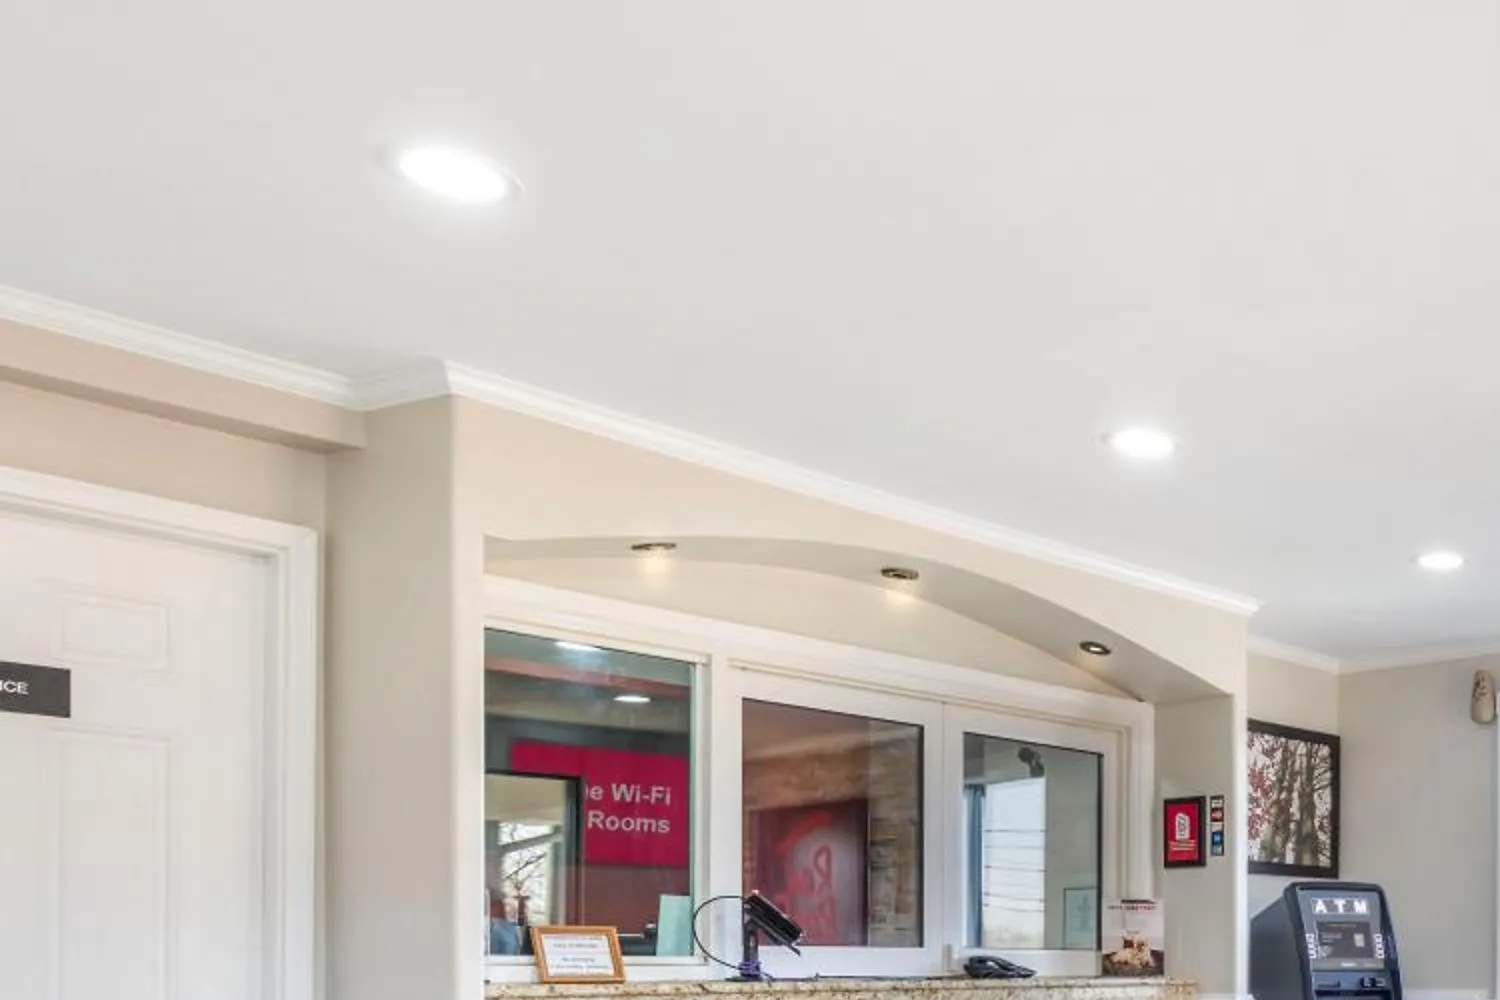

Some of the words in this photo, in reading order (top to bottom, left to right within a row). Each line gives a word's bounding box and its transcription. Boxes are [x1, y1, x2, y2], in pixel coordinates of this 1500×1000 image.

[611, 783, 671, 806] Wi-Fi
[587, 809, 671, 834] Rooms
[1315, 897, 1367, 914] ATM
